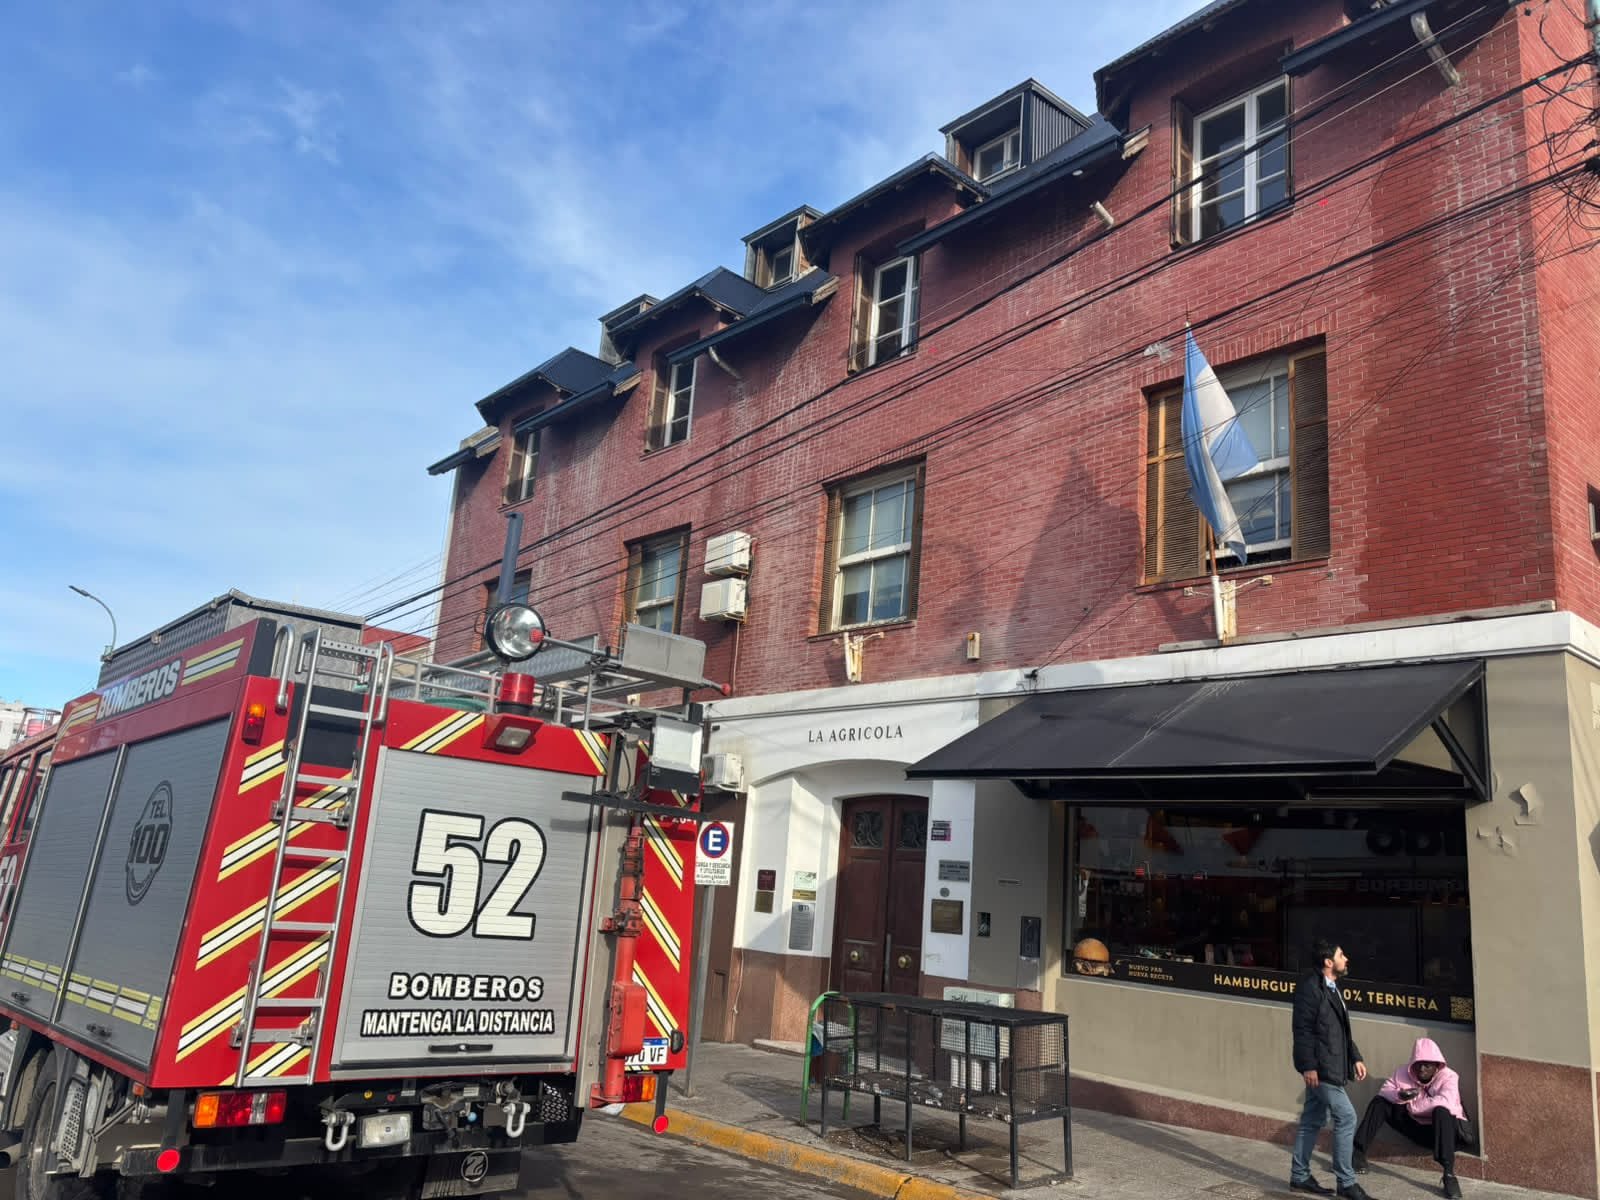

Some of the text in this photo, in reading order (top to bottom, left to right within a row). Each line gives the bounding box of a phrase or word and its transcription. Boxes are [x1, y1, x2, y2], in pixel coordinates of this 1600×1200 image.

[96, 659, 181, 721] BOMBEROS
[809, 725, 903, 742] LA AGRICOLA
[128, 824, 169, 864] 100
[708, 829, 722, 851] E
[408, 809, 546, 939] 52
[389, 973, 543, 1000] BOMBEROS
[1213, 974, 1296, 993] HAMBURGUE
[1368, 991, 1439, 1011] TERNERA
[362, 1010, 554, 1035] MANTENGA LA DISTANCIA
[650, 1047, 664, 1062] VF
